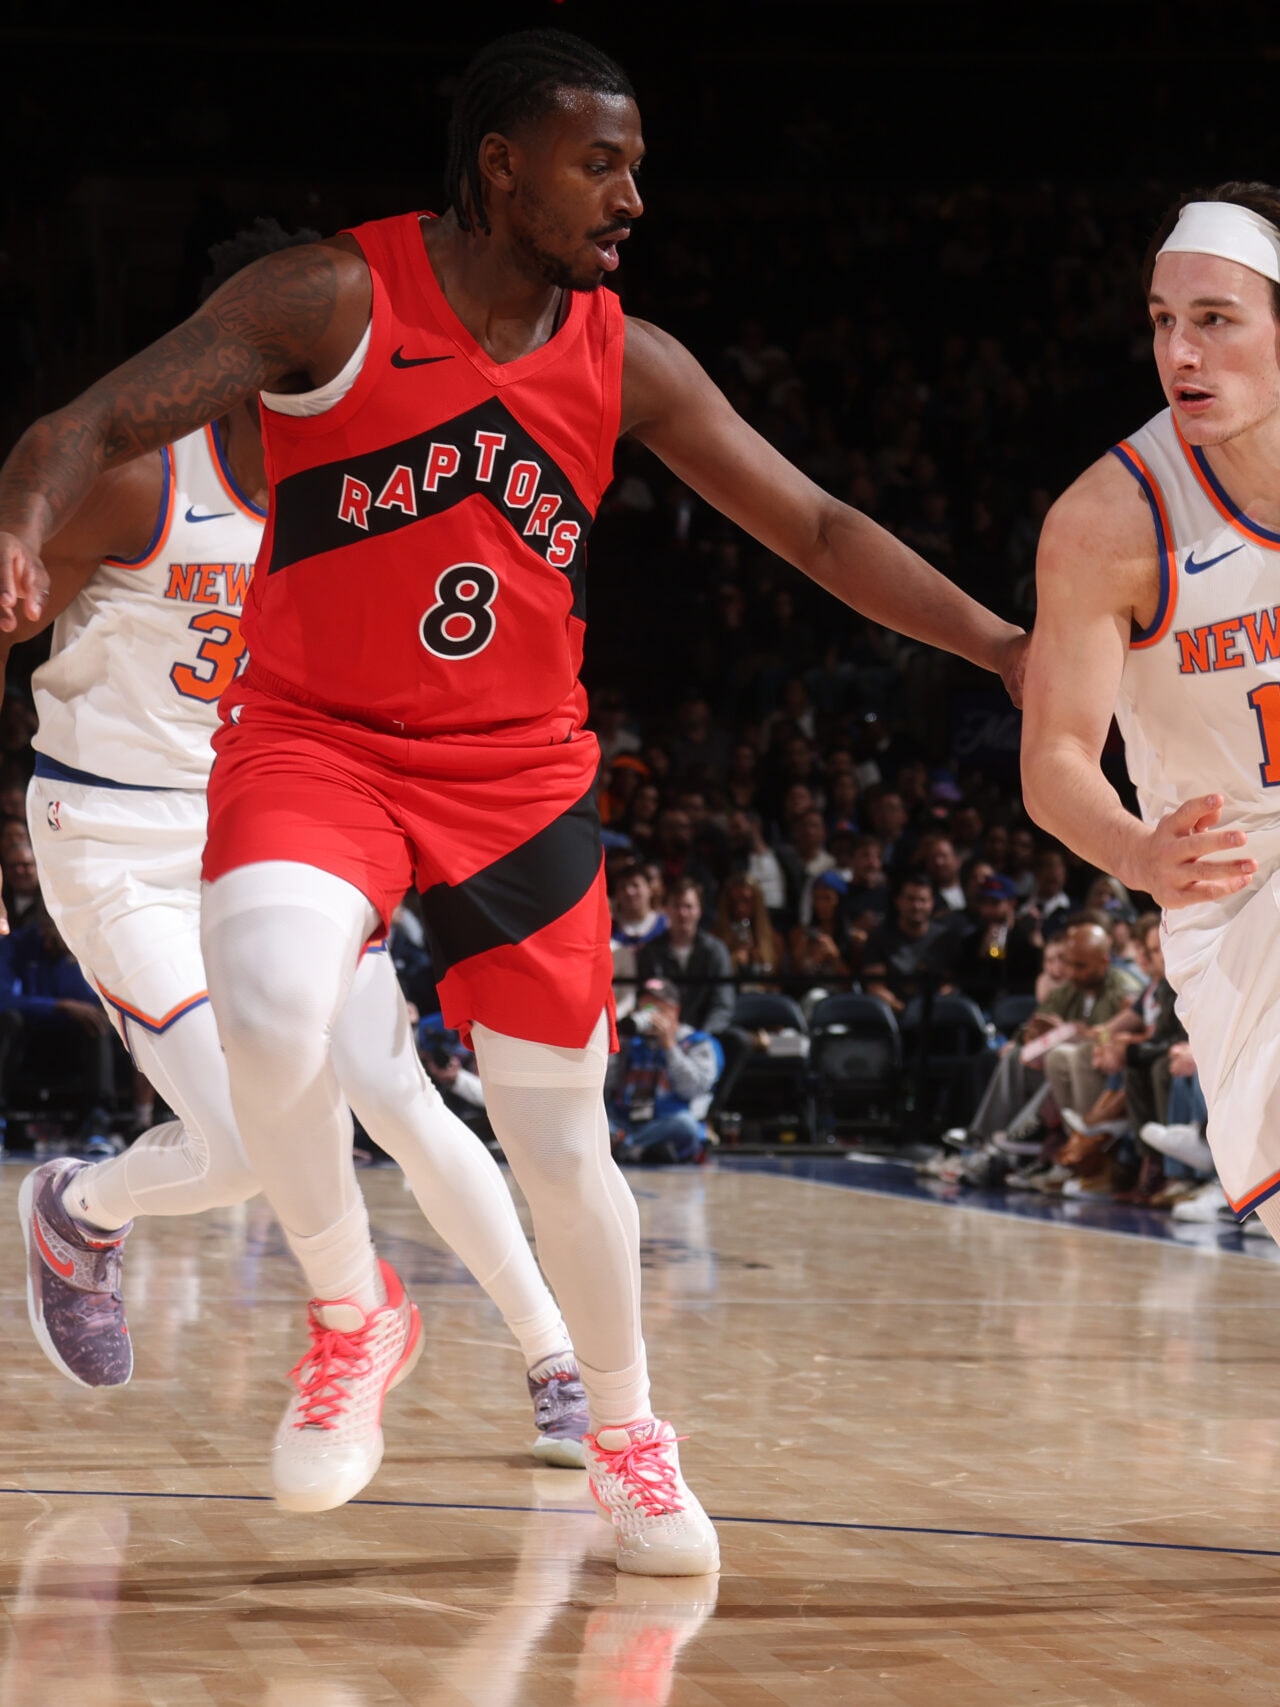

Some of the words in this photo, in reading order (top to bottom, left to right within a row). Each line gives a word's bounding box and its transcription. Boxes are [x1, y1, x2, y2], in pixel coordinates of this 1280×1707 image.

[338, 430, 581, 568] RAPTORS
[164, 563, 255, 606] NEW
[419, 562, 499, 660] 8
